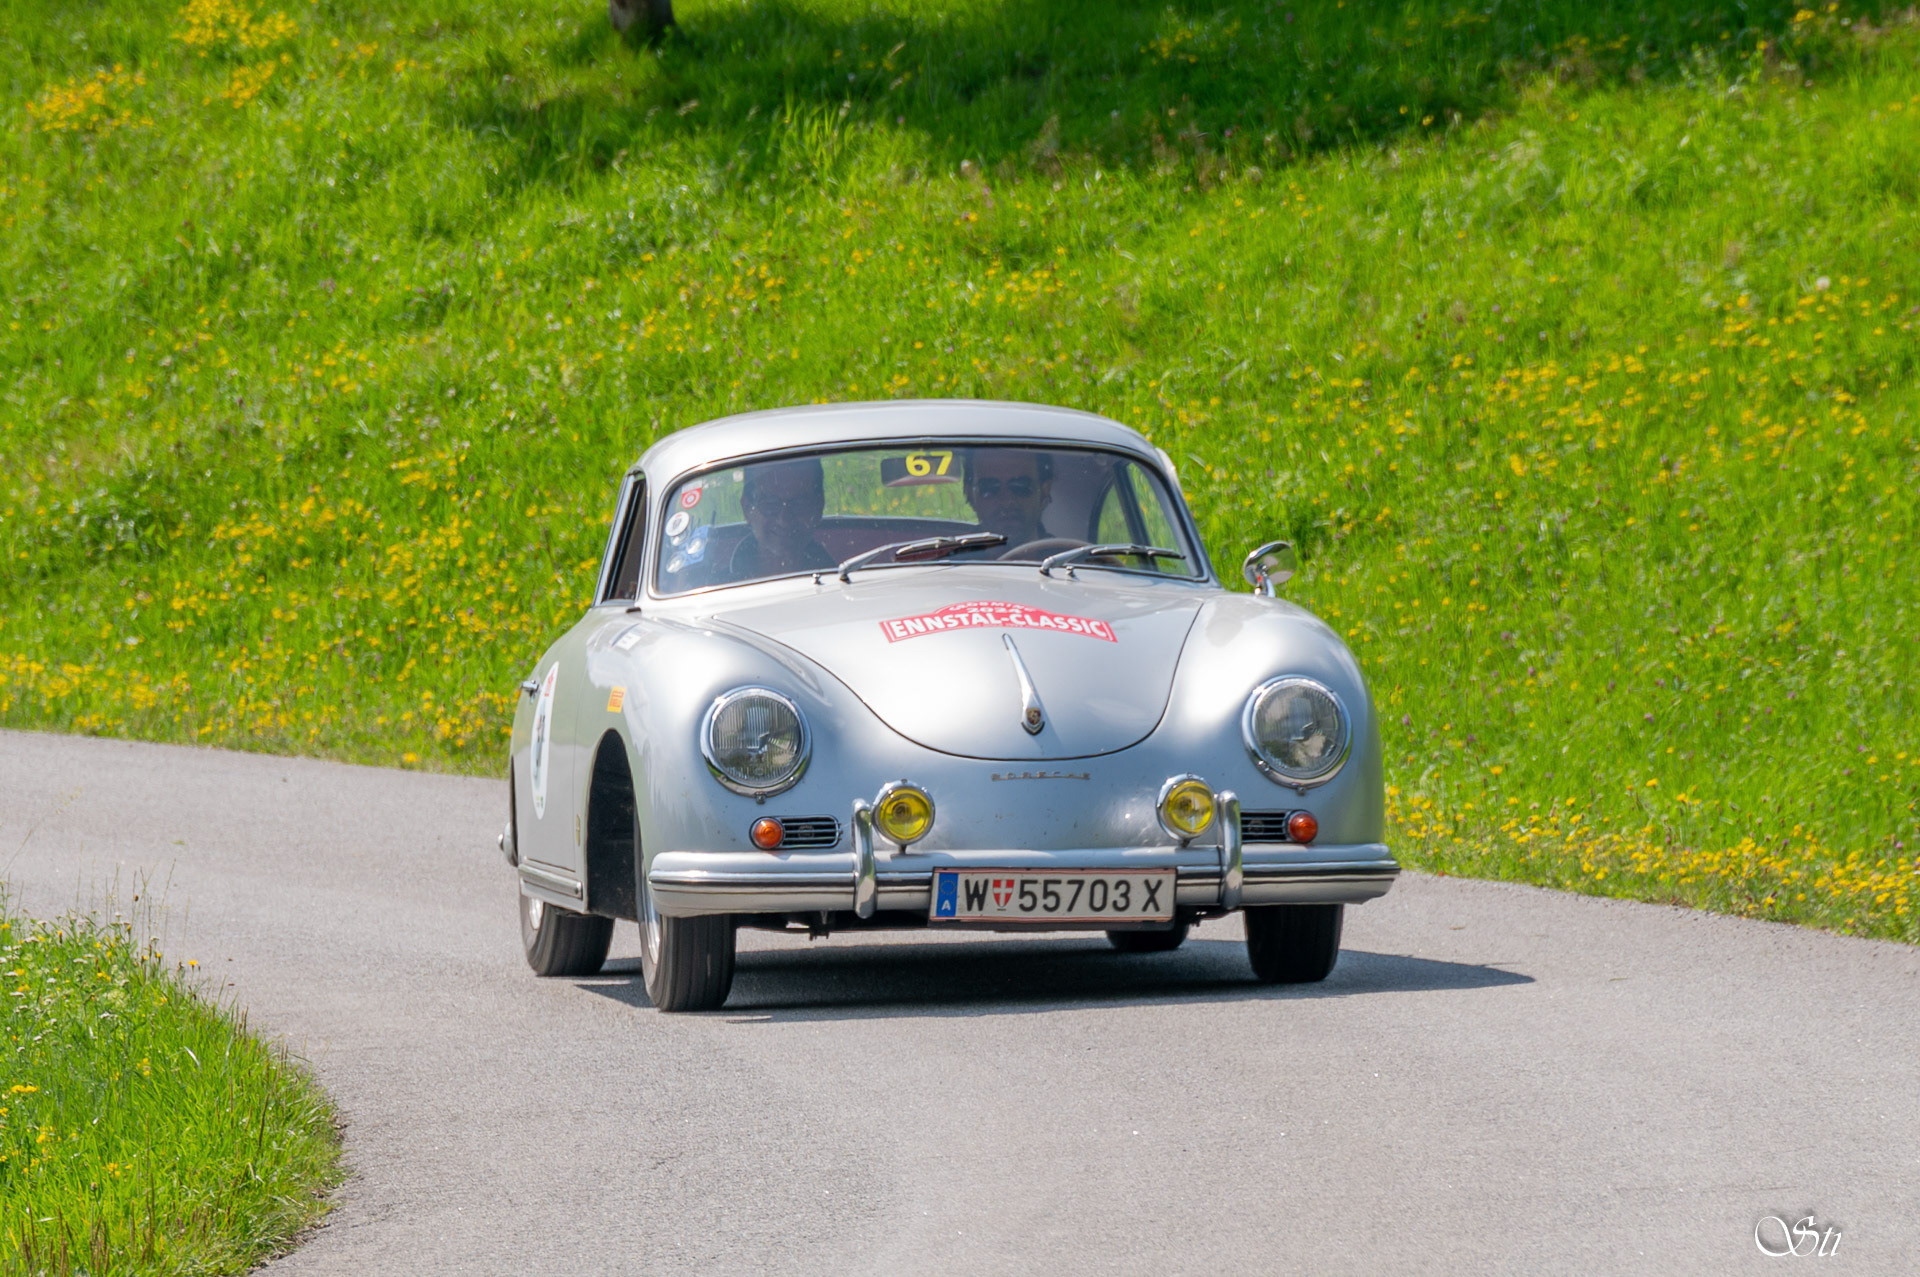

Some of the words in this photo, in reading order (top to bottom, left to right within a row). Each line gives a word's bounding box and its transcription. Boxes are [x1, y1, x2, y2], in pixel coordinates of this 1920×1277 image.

[906, 451, 953, 476] 67
[890, 612, 1108, 638] ENNSTAL-CLASSIC
[941, 900, 951, 911] A
[965, 879, 989, 911] W
[1018, 879, 1131, 912] 55703
[1142, 879, 1163, 912] X
